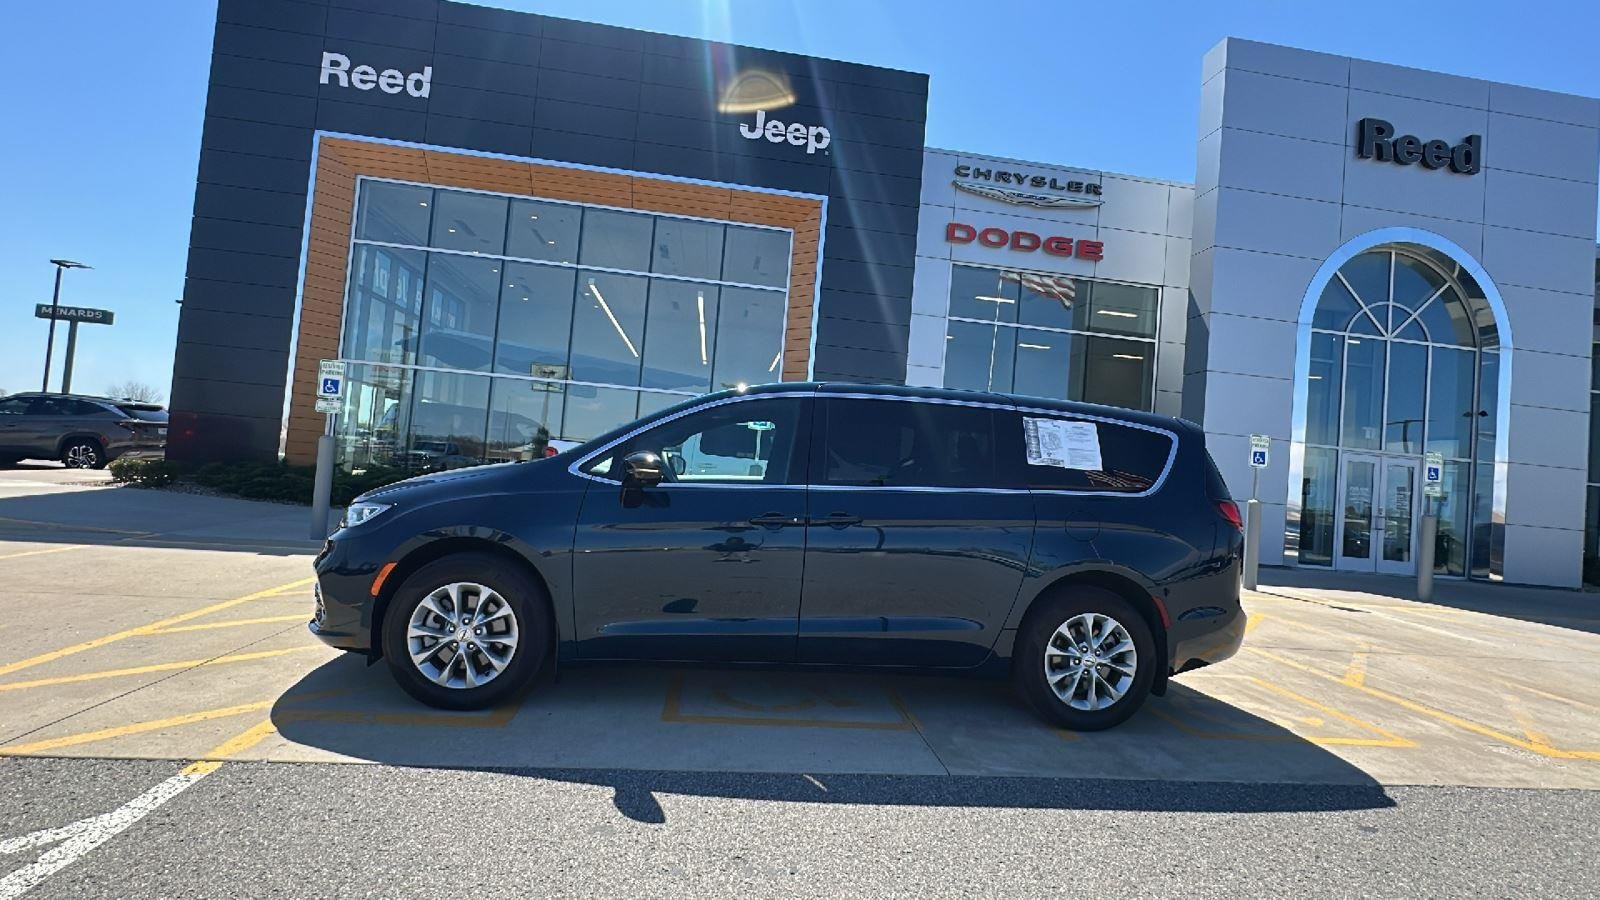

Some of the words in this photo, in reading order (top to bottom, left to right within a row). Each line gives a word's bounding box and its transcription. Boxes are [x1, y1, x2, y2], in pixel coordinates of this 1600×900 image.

[320, 51, 433, 98] Reed
[740, 109, 831, 154] Jeep
[1357, 117, 1482, 175] Reed
[954, 164, 1103, 195] CHRYSLER
[946, 222, 1104, 261] DODGE
